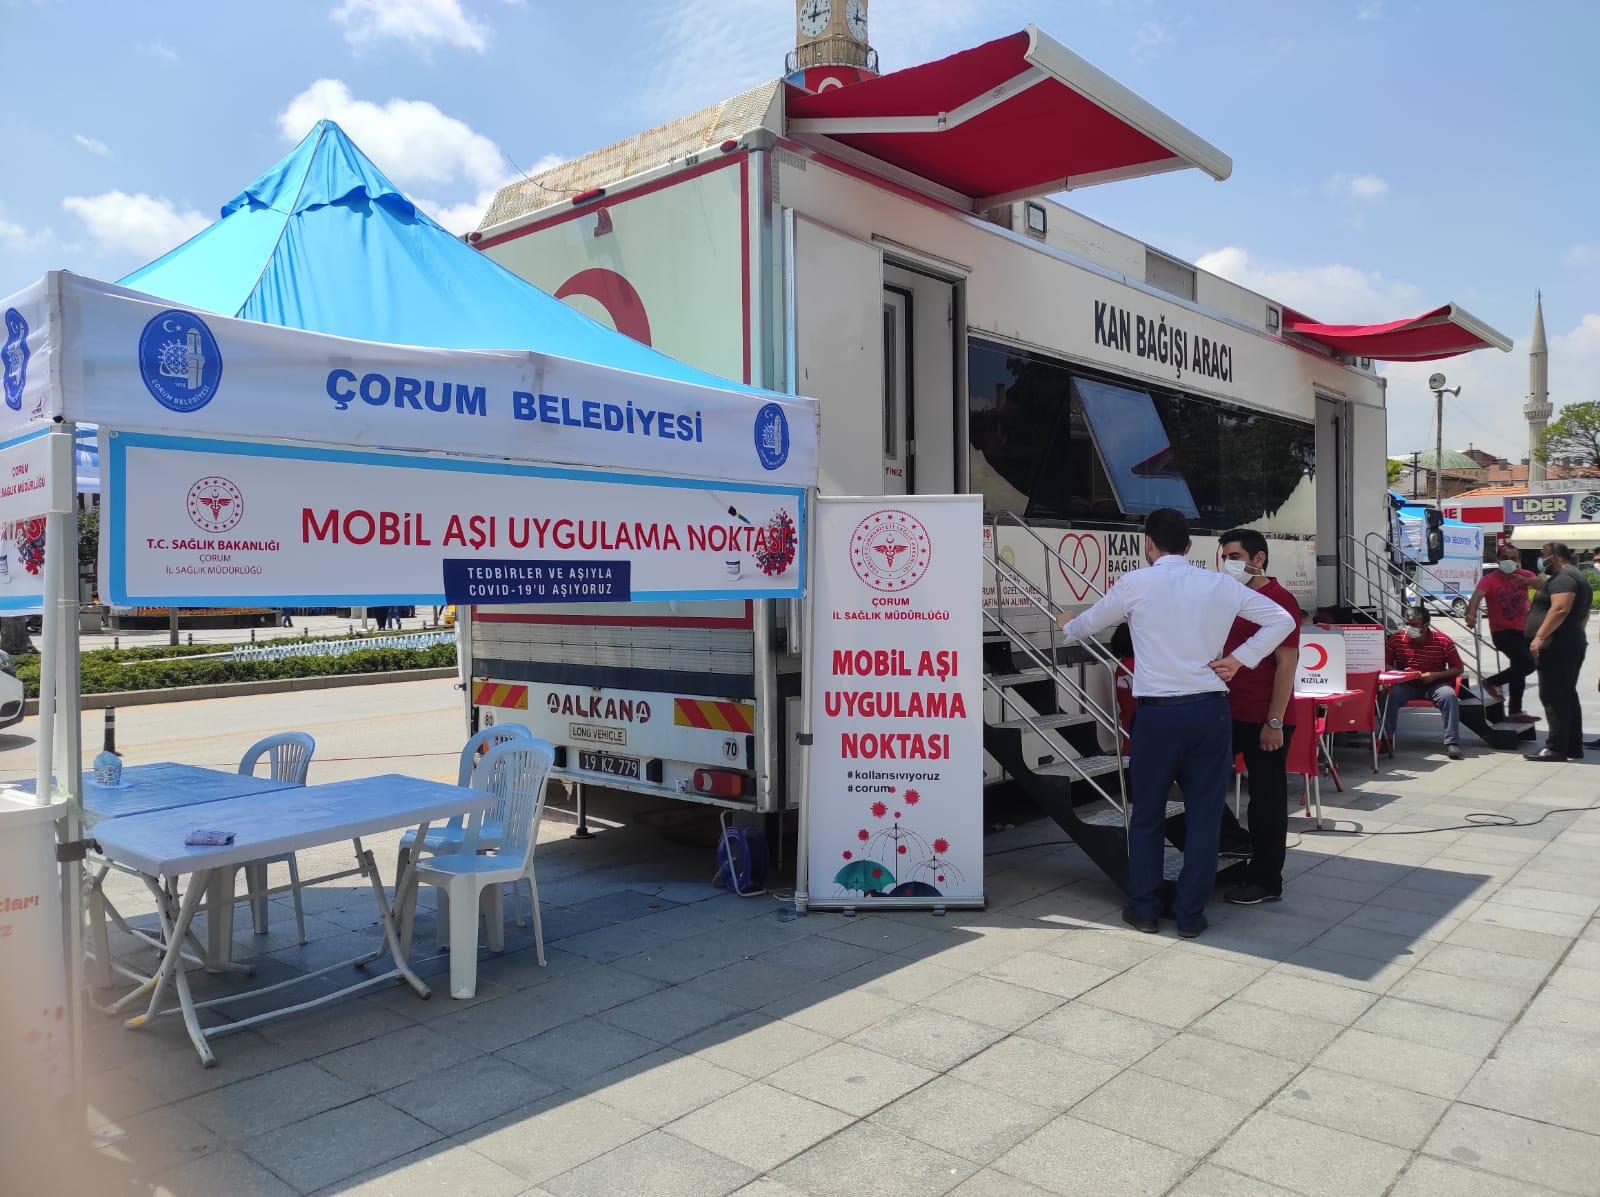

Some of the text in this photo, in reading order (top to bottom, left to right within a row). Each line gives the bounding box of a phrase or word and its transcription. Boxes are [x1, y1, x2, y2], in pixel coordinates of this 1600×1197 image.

[1095, 300, 1233, 383] KAN BAĞIŞI ARACI
[326, 368, 703, 443] ÇORUM BELEDİYESİ
[1525, 513, 1555, 521] saat
[443, 514, 496, 551] AŞI
[509, 516, 680, 551] UYGULAMA
[687, 525, 787, 553] NOKTASI
[146, 538, 280, 551] T.C. SAĞLIK BAKANLIĞI
[1108, 533, 1140, 556] KAN
[199, 554, 231, 563] ÇORUM
[166, 564, 263, 575] İL SAĞLIK MÜDÜRLÜĞÜ
[467, 565, 612, 582] TEDBİRLER VE AŞIYLA
[469, 583, 613, 597] COVID-19'U AŞIYORUZ
[872, 597, 910, 607] ÇORUM
[844, 610, 881, 620] SAĞLIK
[884, 609, 950, 620] MÜDÜRLÜĞÜ
[917, 650, 958, 682] AŞI
[824, 691, 967, 719] UYGULAMA
[572, 726, 623, 742] LONG VEHICLE
[725, 742, 737, 757] 70
[841, 733, 950, 760] NOKTASI
[584, 754, 638, 777] 19 KZ 779
